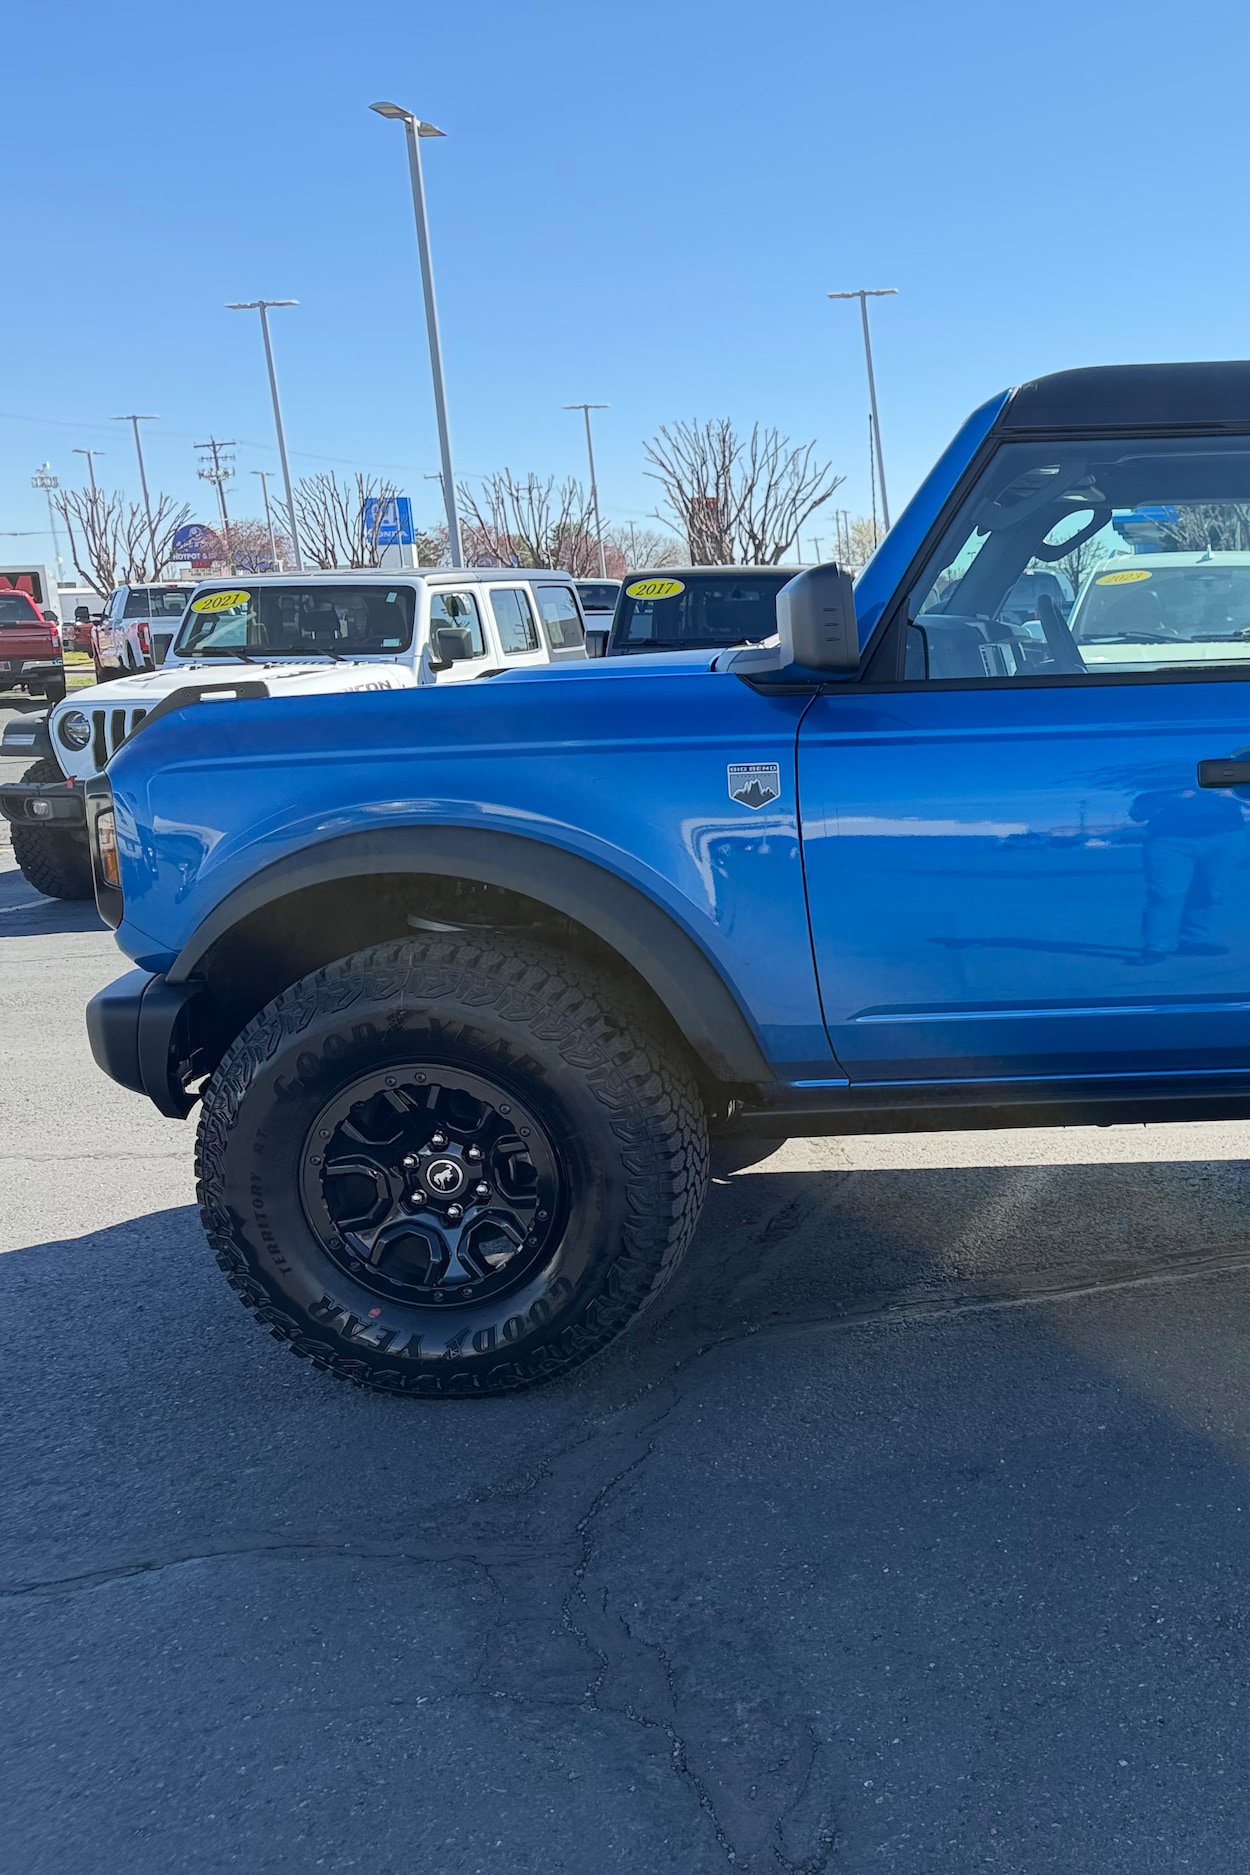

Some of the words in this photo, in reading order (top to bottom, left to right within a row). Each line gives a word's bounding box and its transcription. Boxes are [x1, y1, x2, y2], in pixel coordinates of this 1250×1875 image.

[636, 582, 675, 596] 2017
[201, 593, 242, 611] 2021
[249, 1171, 295, 1278] TERRITORY
